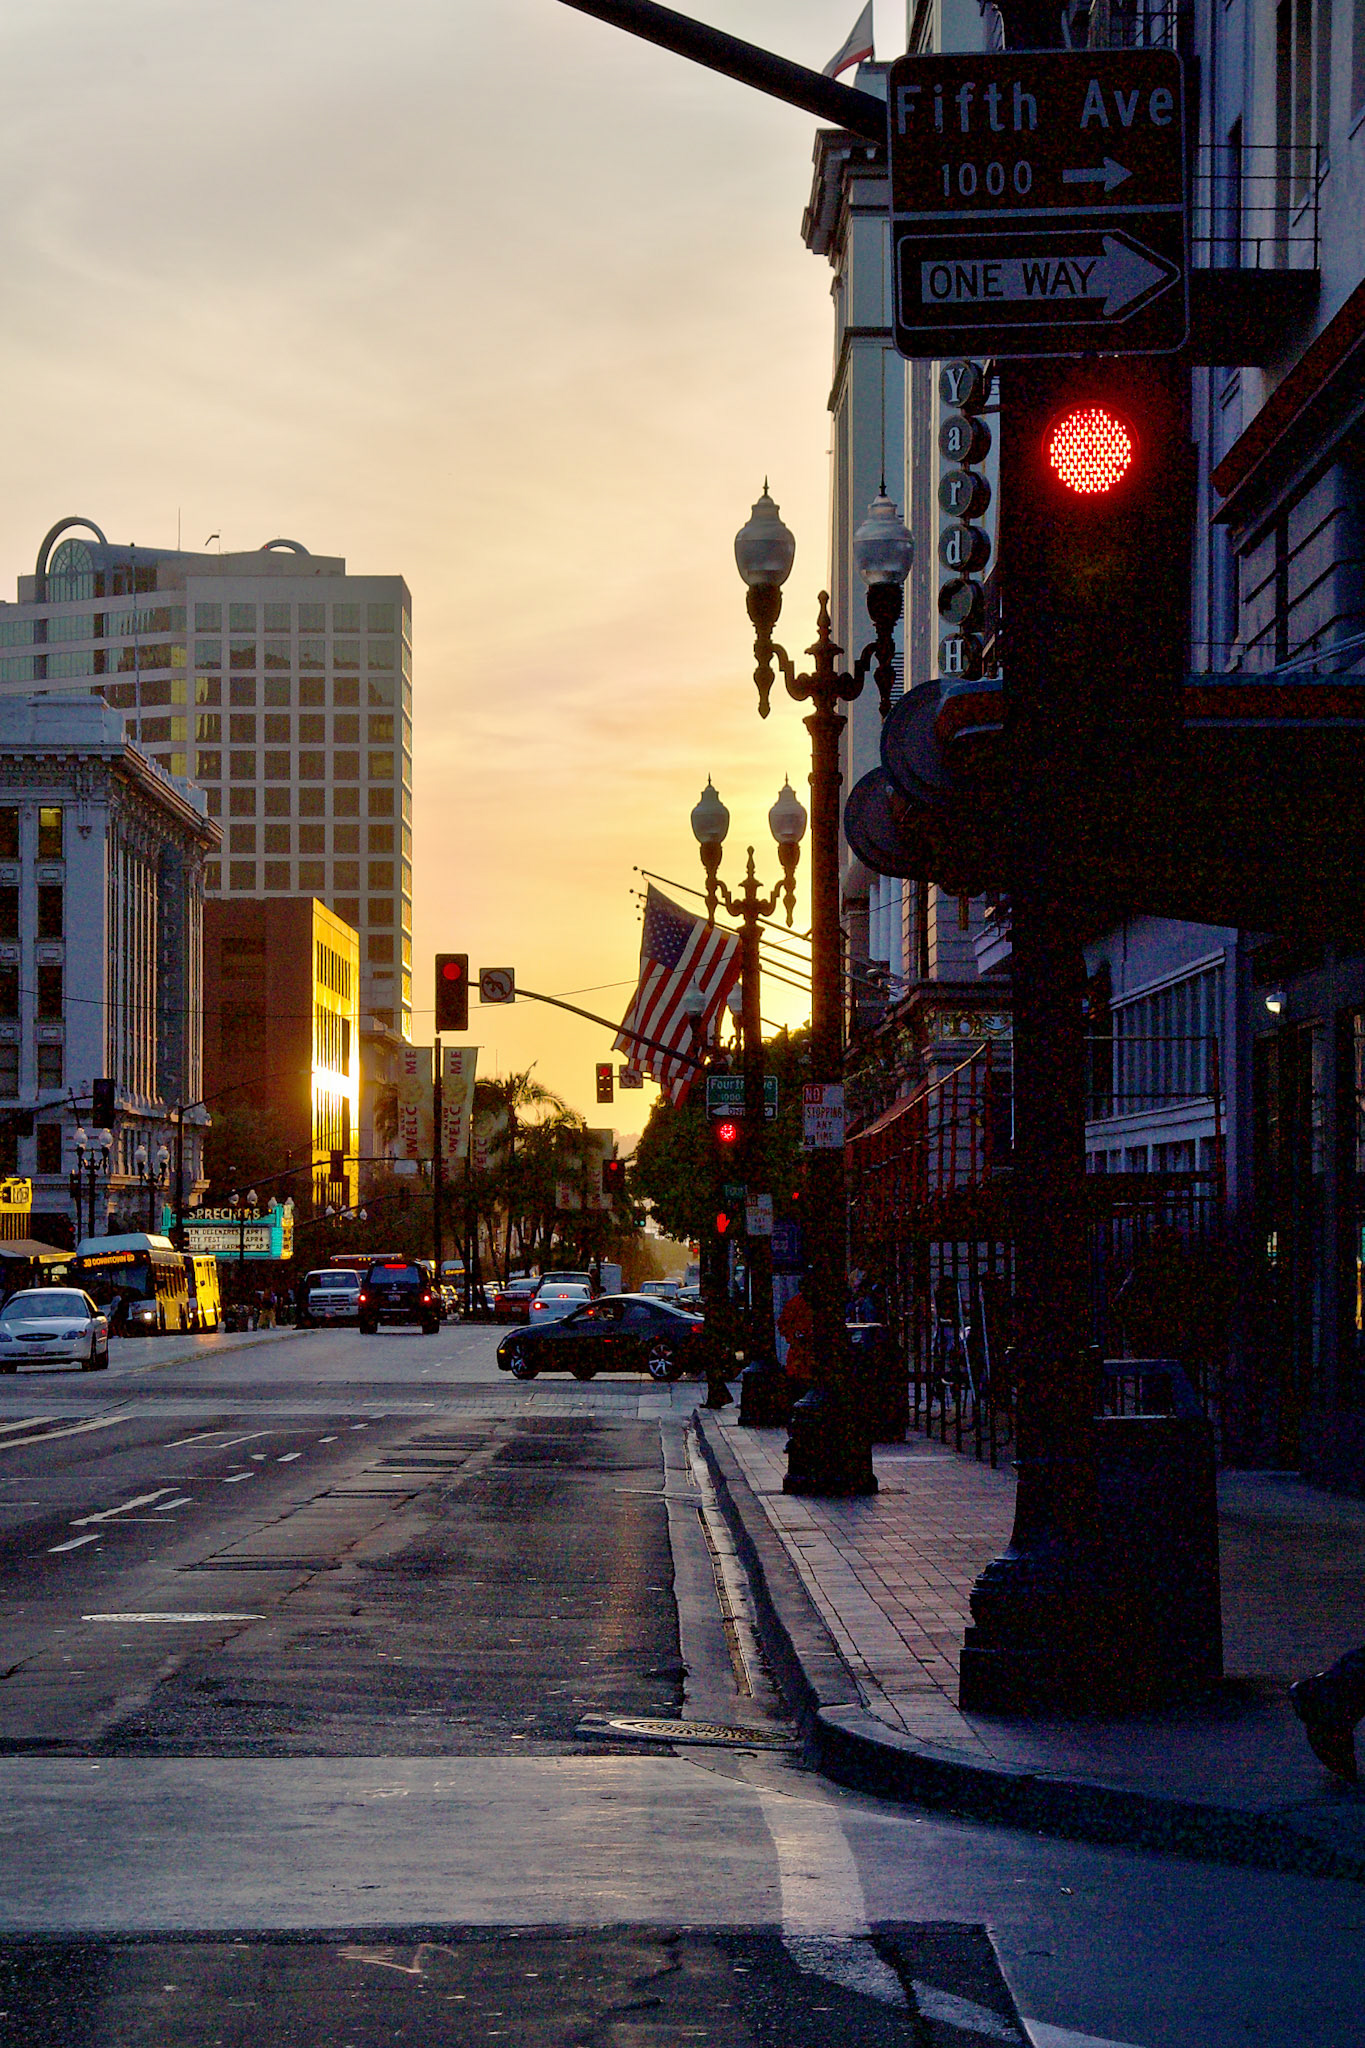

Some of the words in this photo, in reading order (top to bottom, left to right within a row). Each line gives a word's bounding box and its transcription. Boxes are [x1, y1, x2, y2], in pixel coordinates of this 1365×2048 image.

[896, 80, 1038, 135] Fifth
[1079, 79, 1174, 129] Ave
[941, 160, 1032, 197] 1000
[928, 264, 1003, 298] ONE
[1022, 260, 1096, 296] WAY
[945, 368, 966, 566] Yard
[805, 1088, 820, 1102] NO
[807, 1106, 843, 1119] STOPPING
[816, 1120, 832, 1129] ANY
[815, 1132, 833, 1141] TIME
[188, 1208, 261, 1220] SPRECKS
[92, 1255, 127, 1266] DOWNTOWN
